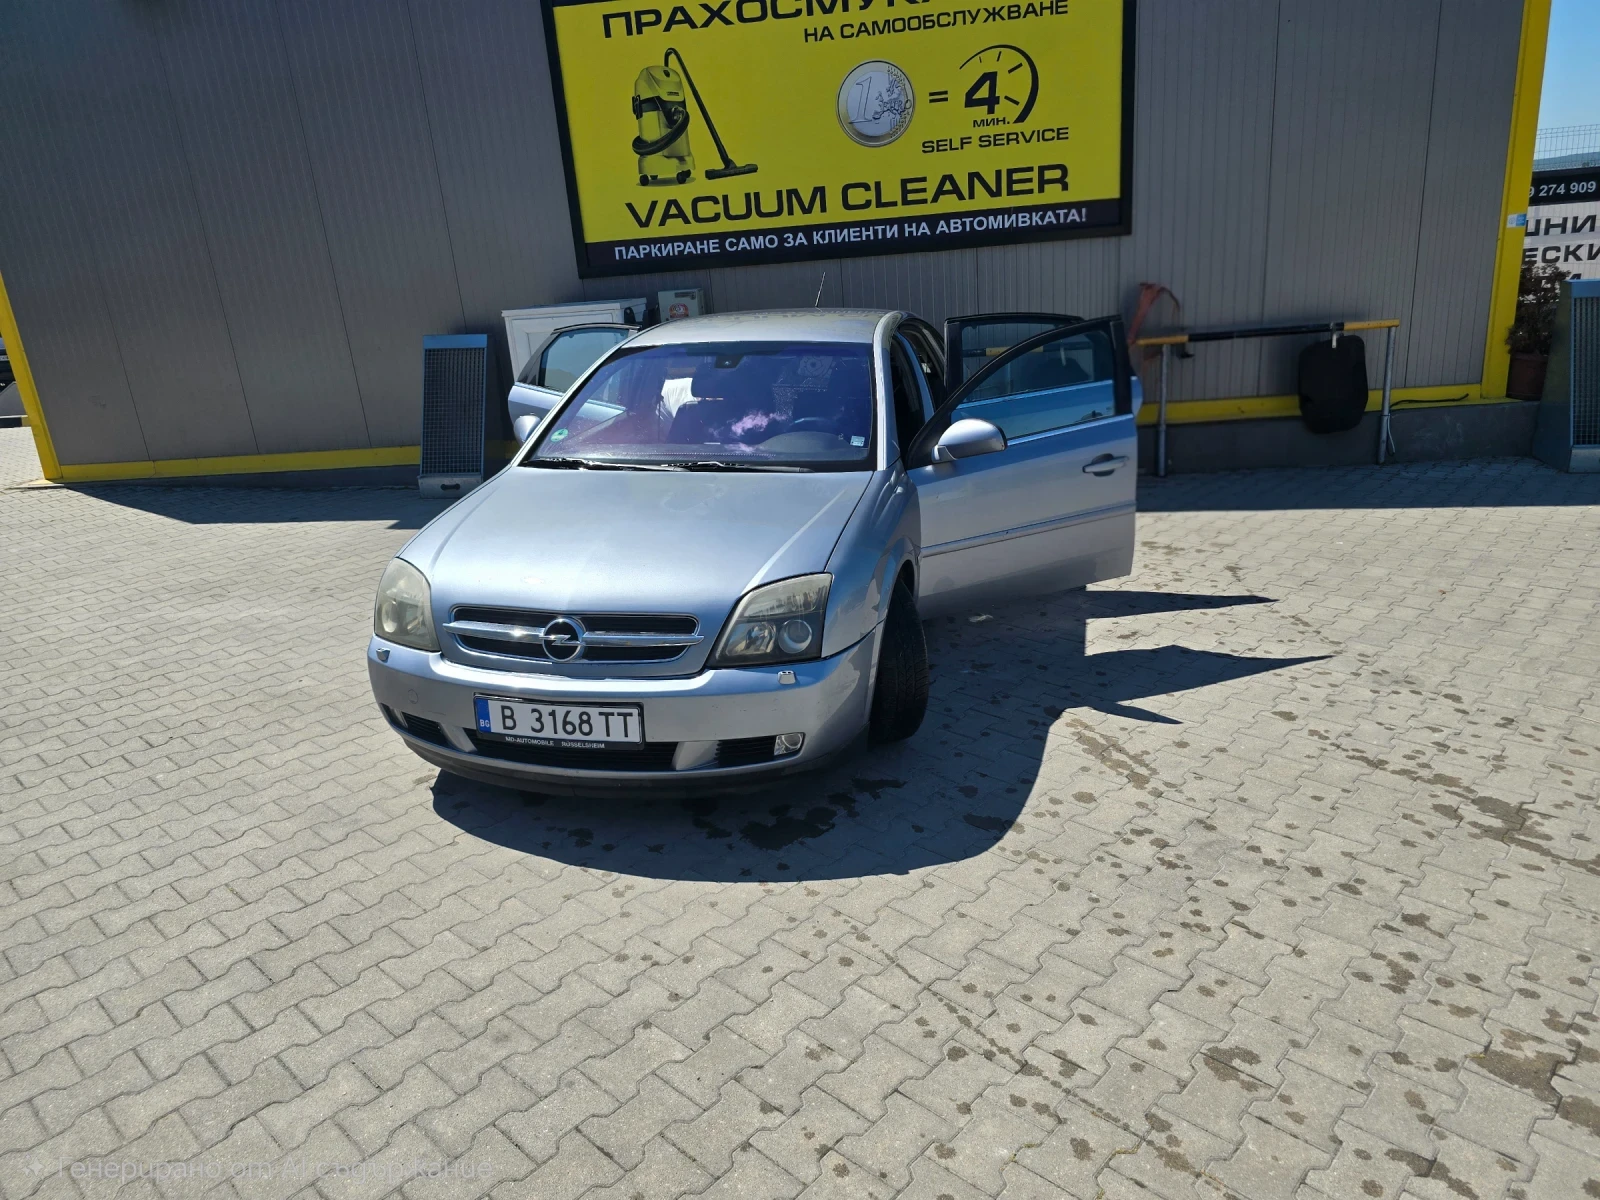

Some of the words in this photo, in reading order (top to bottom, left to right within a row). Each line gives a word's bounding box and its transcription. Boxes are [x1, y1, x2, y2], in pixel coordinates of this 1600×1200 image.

[602, 0, 932, 38] ПРАХОСМ
[804, 26, 834, 43] НА
[841, 0, 1068, 38] САМООБСЛУЖВАНЕ
[964, 71, 1001, 115] 4
[921, 136, 973, 154] SELF
[978, 126, 1070, 148] SERVICE
[972, 116, 1011, 128] МИН.
[625, 187, 828, 228] VACUUM
[841, 163, 1070, 211] CLEANER
[1539, 184, 1565, 197] 274
[1570, 181, 1597, 194] 909
[614, 239, 721, 261] ПАРКИРАНЕ
[725, 234, 779, 253] САМО
[783, 231, 808, 247] ЗА
[812, 223, 899, 245] КЛИЕНТИ
[904, 220, 931, 237] НА
[935, 207, 1087, 235] АВТОМИВКАТА!
